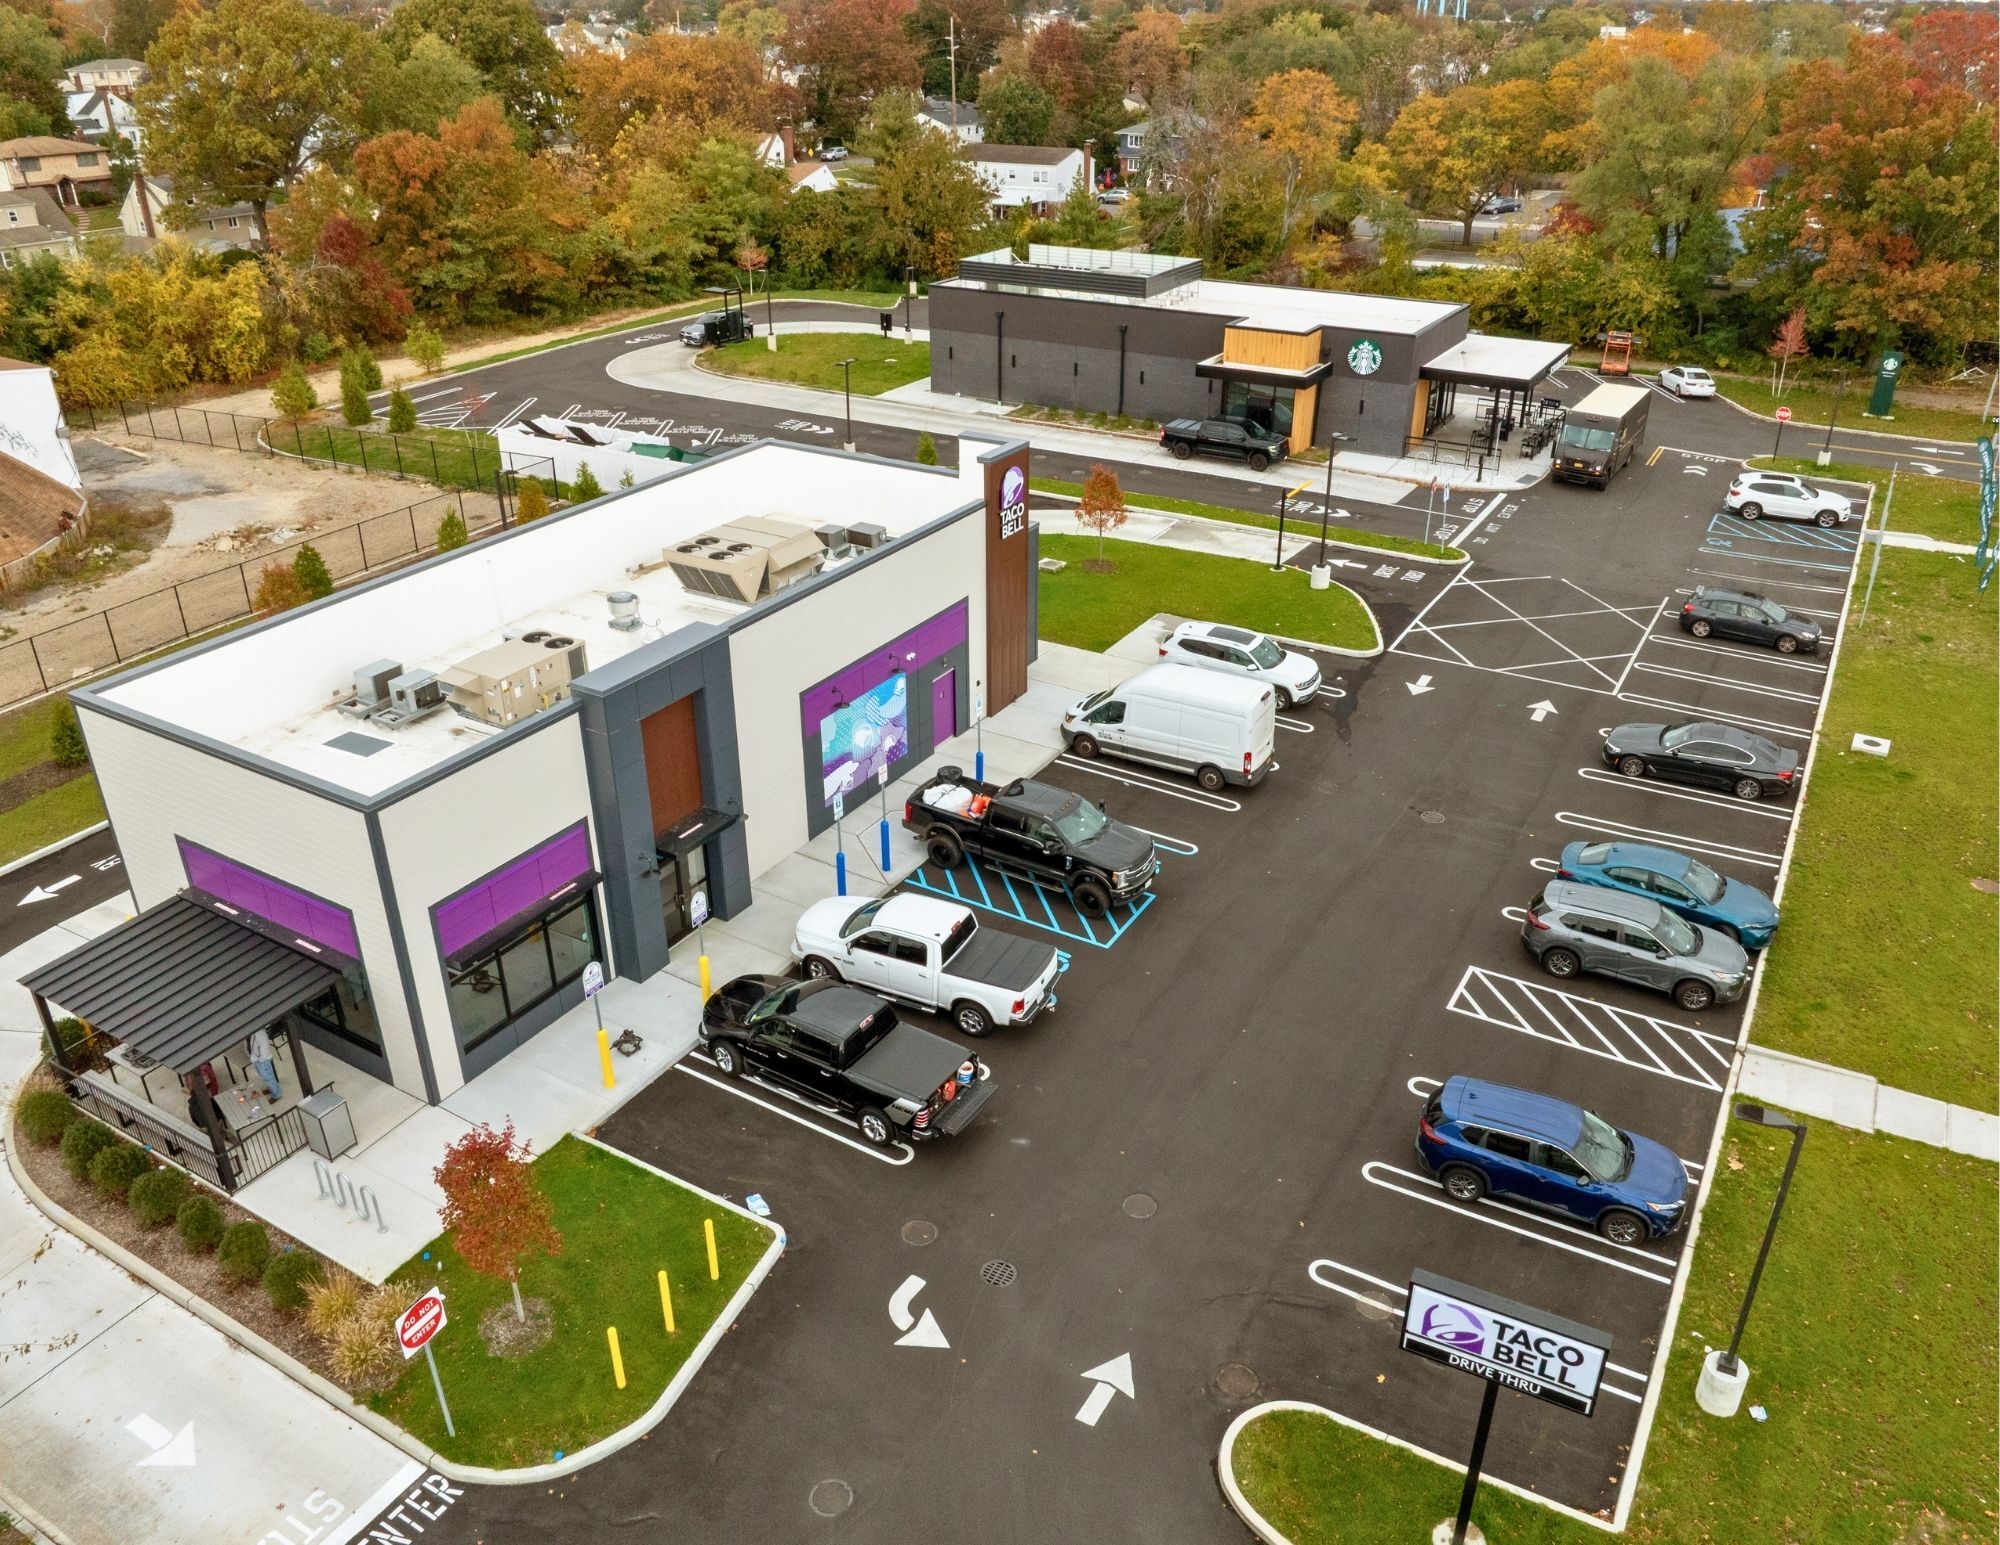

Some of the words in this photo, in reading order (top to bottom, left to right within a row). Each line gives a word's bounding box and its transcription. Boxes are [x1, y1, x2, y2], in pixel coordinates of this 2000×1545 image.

[1681, 452, 1727, 463] STOP
[1000, 502, 1025, 525] TACO
[1461, 498, 1485, 513] STOP
[1002, 517, 1024, 540] BELL
[1433, 524, 1459, 539] STOP
[892, 1104, 914, 1115] HEMI
[404, 1316, 416, 1329] DO
[419, 1299, 434, 1317] NOT
[411, 1318, 437, 1344] ENTER
[1492, 1319, 1585, 1367] TACO
[1448, 1353, 1495, 1379] DRIVE
[1498, 1371, 1541, 1394] THRU
[1492, 1342, 1577, 1388] BELL
[356, 1474, 465, 1545] NTER
